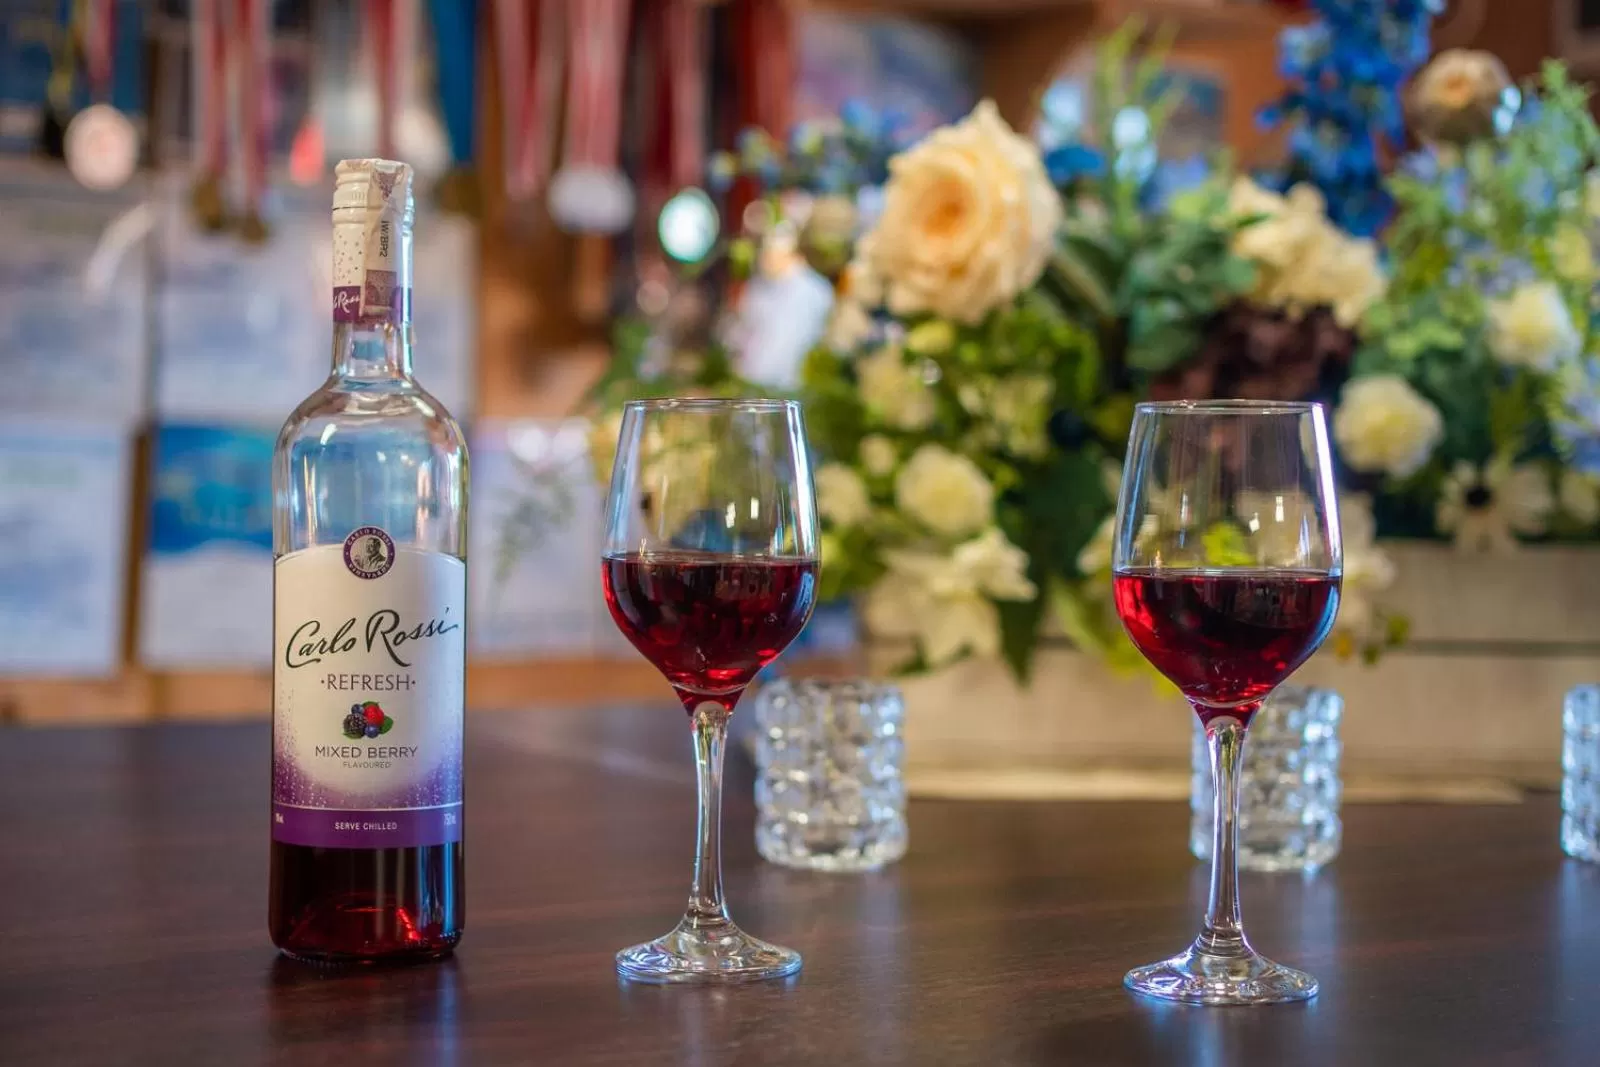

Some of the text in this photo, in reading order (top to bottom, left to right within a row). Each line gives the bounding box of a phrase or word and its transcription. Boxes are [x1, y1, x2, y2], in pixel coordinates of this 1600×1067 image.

[286, 607, 459, 669] Carlo Rossi
[326, 673, 410, 691] REFRESH
[315, 746, 418, 759] MIXED BERRY
[335, 822, 398, 830] SERVE CHILLED
